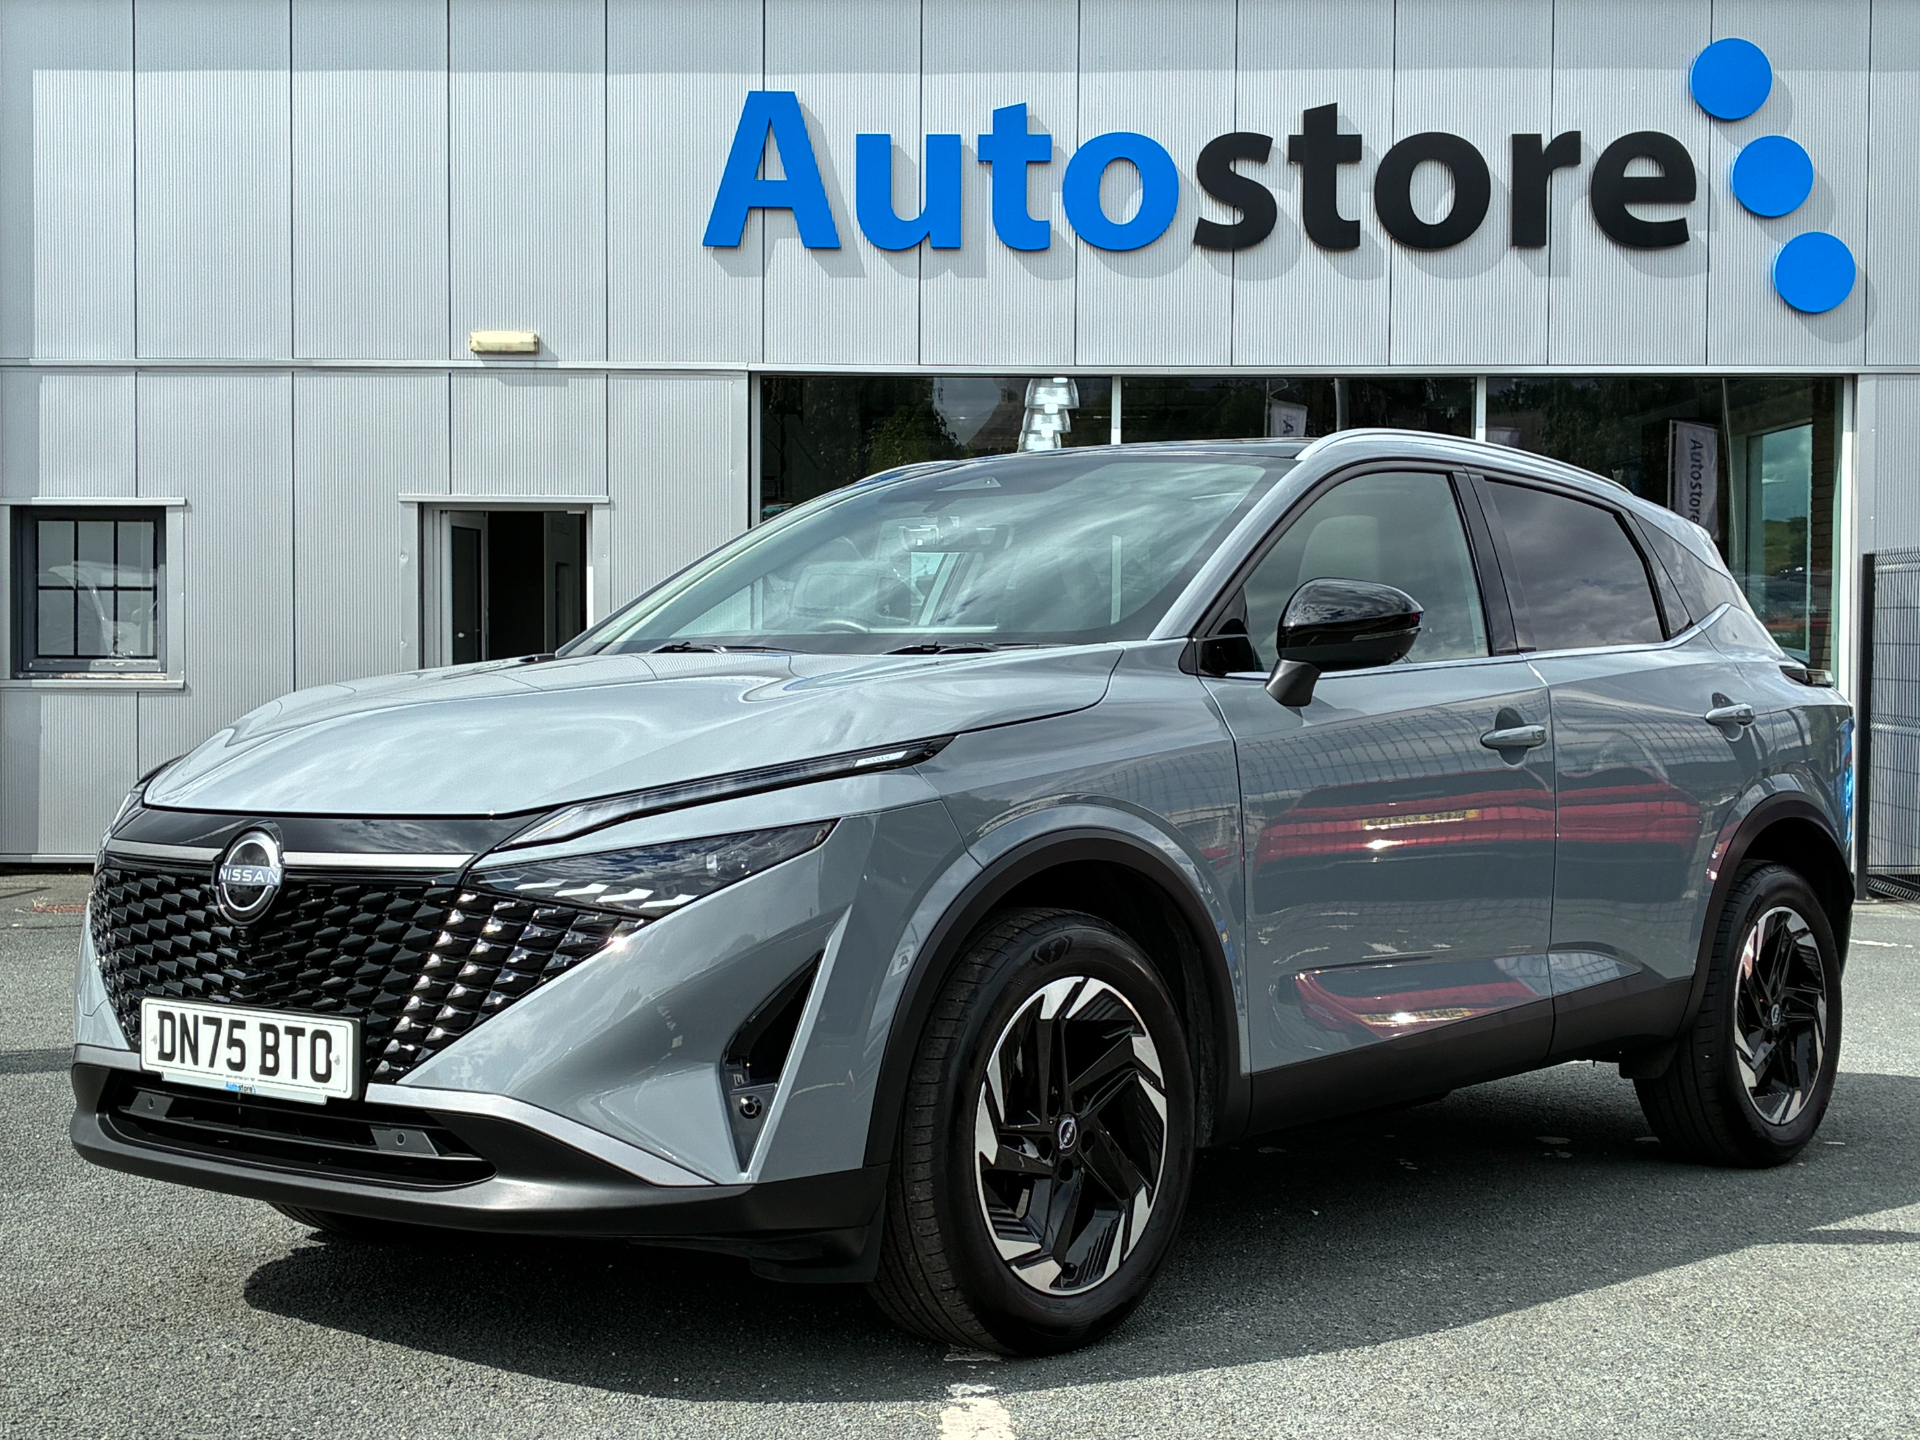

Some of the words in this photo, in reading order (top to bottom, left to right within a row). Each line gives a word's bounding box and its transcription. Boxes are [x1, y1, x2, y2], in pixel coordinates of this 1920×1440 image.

[703, 90, 1697, 252] Autostore
[218, 867, 281, 883] NISSAN
[158, 1009, 246, 1072] DN75
[259, 1022, 333, 1084] BTO
